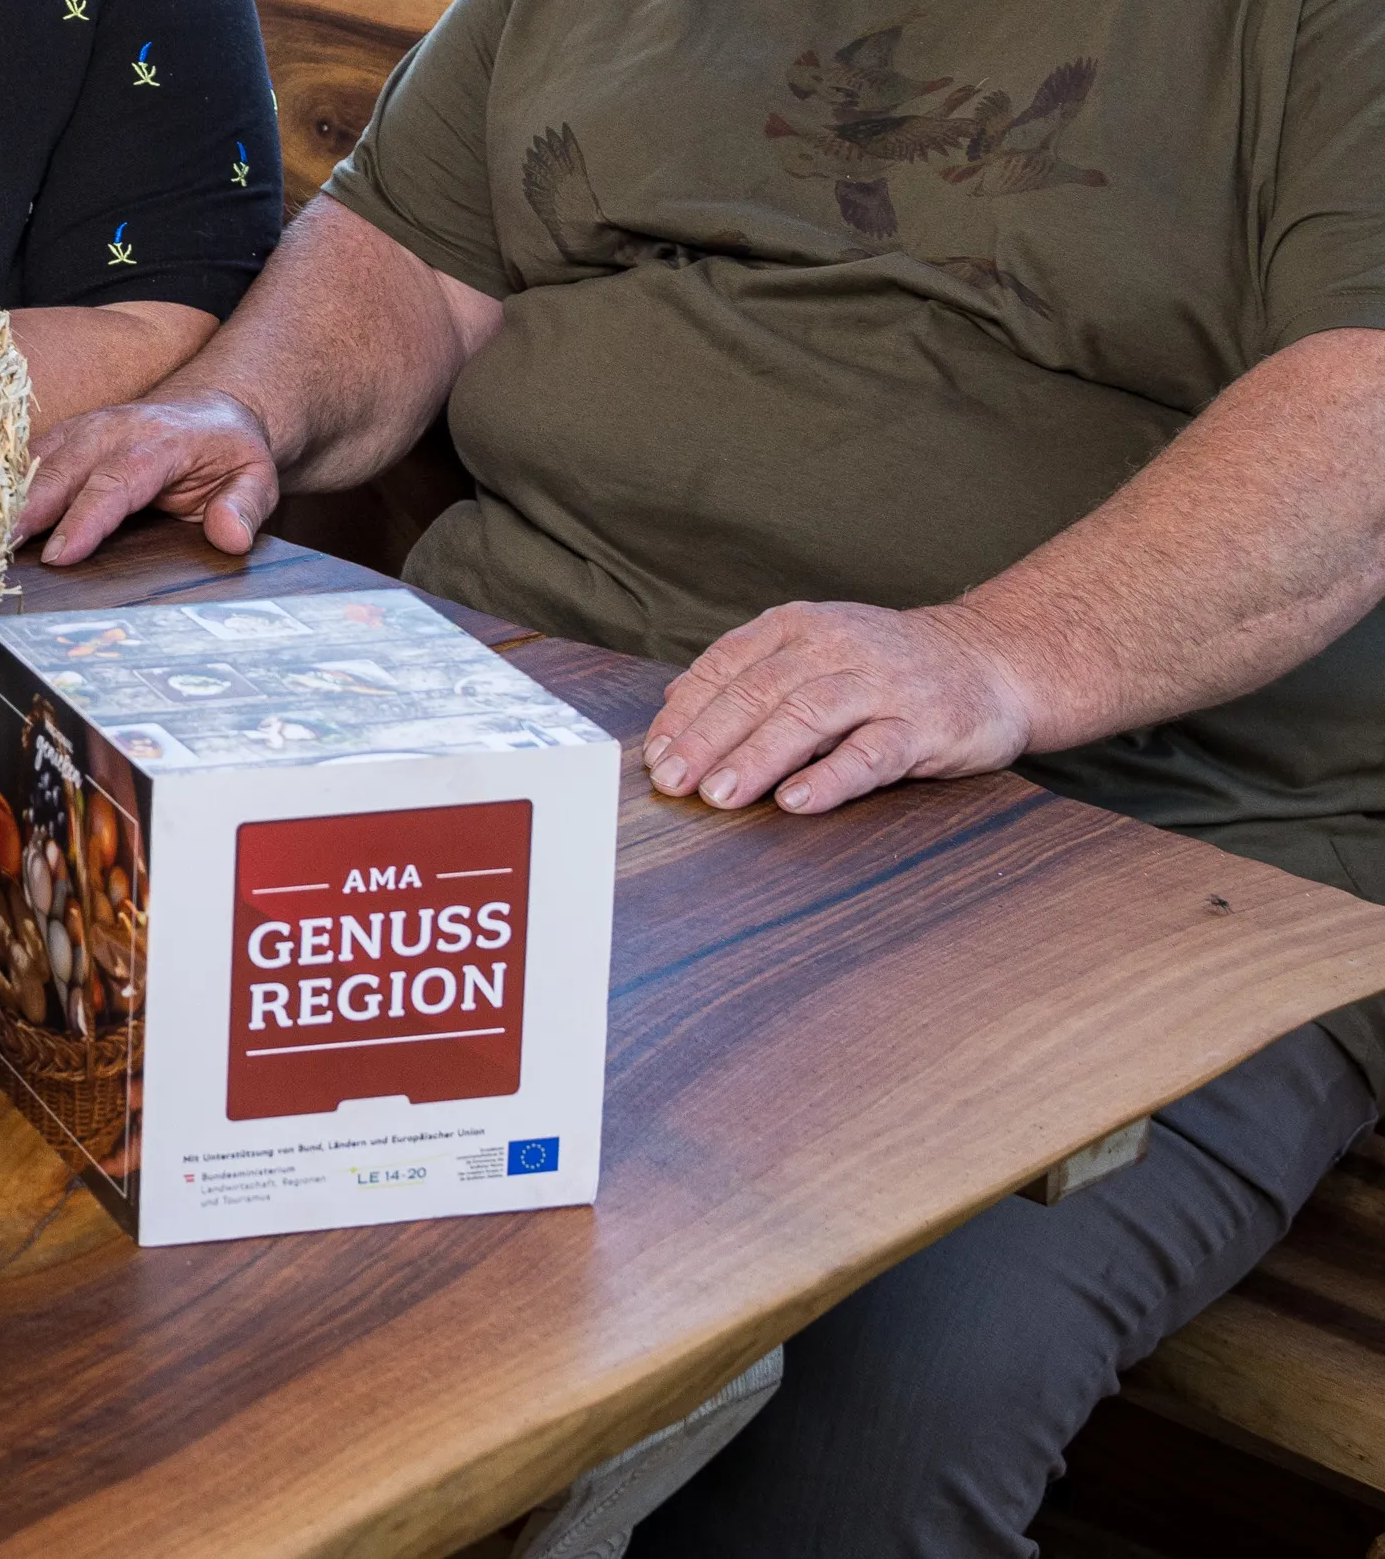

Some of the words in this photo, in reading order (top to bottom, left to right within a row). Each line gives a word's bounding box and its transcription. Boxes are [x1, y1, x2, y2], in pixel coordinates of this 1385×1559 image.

[342, 864, 423, 894] AMA
[247, 901, 513, 970] GENUSS
[247, 961, 508, 1031] REGION
[182, 1155, 199, 1163] Mit
[203, 1148, 274, 1163] Unterstützung
[278, 1147, 294, 1155] von
[298, 1143, 324, 1153] Bund,
[329, 1137, 367, 1150] Ländern
[370, 1137, 389, 1146] und
[391, 1129, 454, 1144] Europäischer
[457, 1127, 486, 1138] Union
[201, 1165, 296, 1182] Bundesministerium
[282, 1175, 327, 1188] Regionen
[357, 1171, 381, 1185] LE
[200, 1197, 219, 1208] und
[223, 1194, 271, 1206] Tourismus
